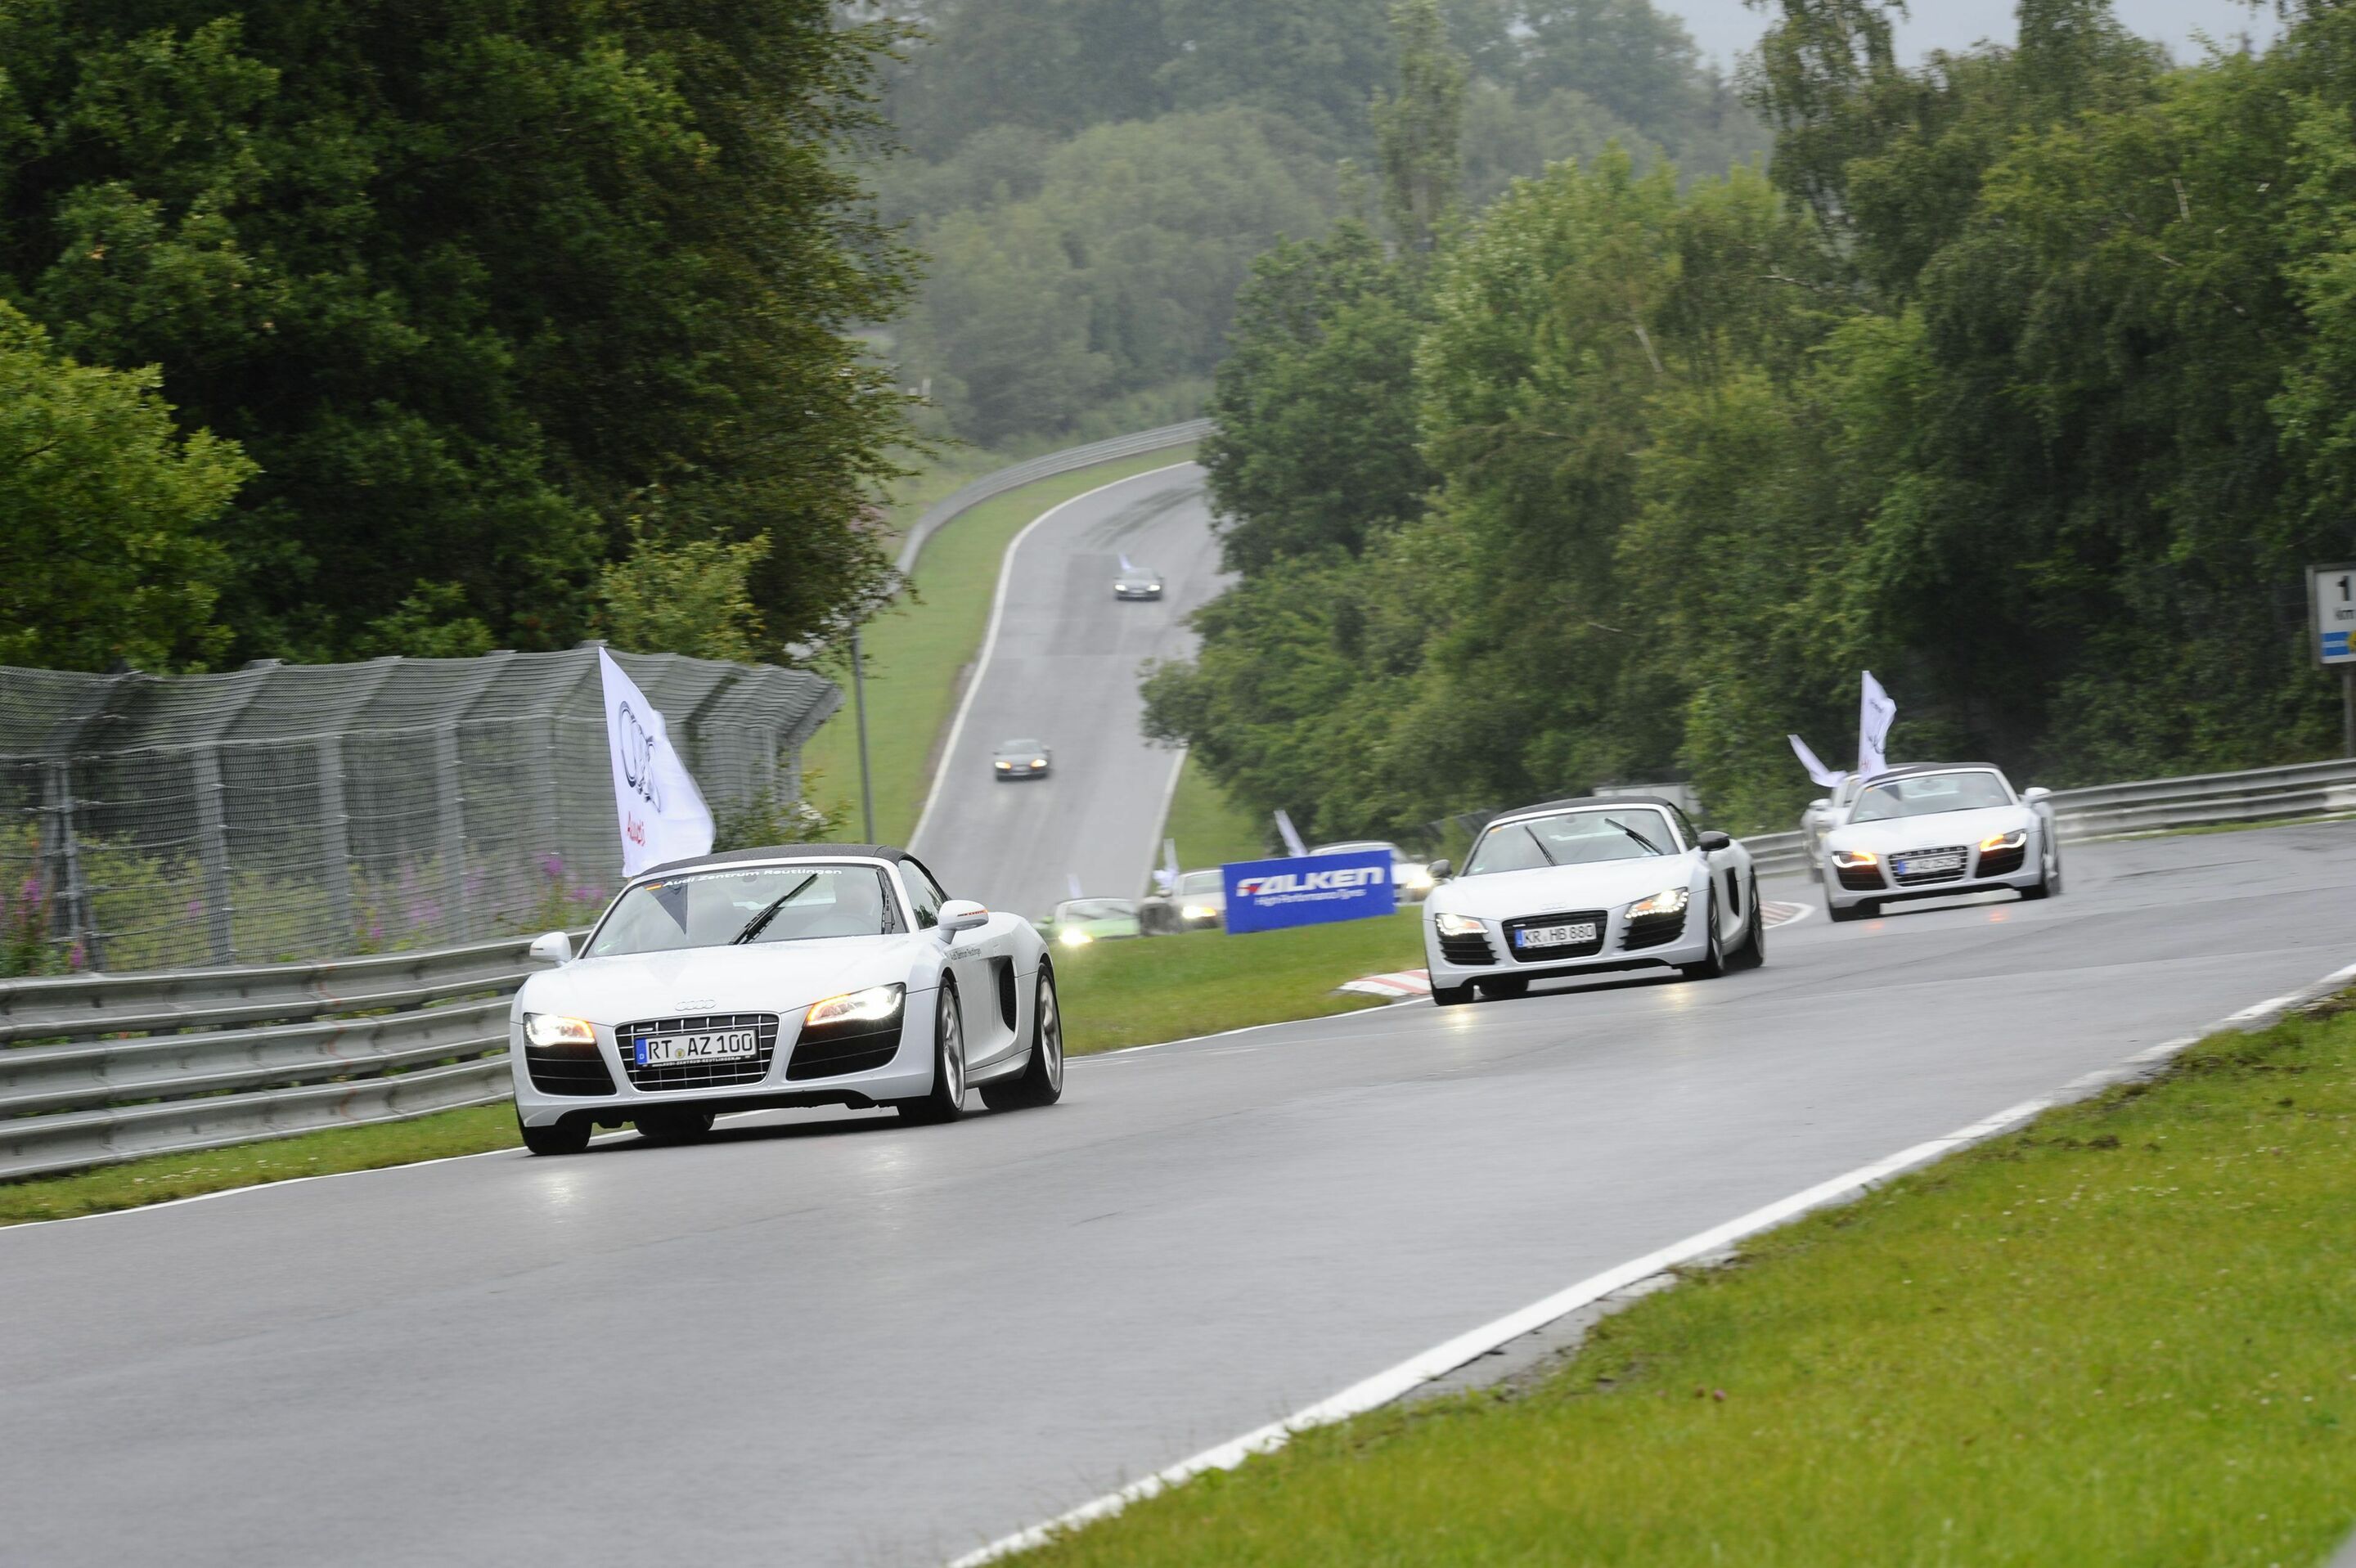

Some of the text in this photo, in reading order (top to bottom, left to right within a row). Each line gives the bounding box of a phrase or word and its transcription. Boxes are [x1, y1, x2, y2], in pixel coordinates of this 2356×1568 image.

[663, 877, 695, 887] Audi
[697, 871, 760, 883] Zentrum
[1235, 867, 1385, 897] FALKEN
[1525, 930, 1541, 944] KR
[1549, 928, 1567, 941] HB
[649, 1033, 753, 1060] RT AZ 100
